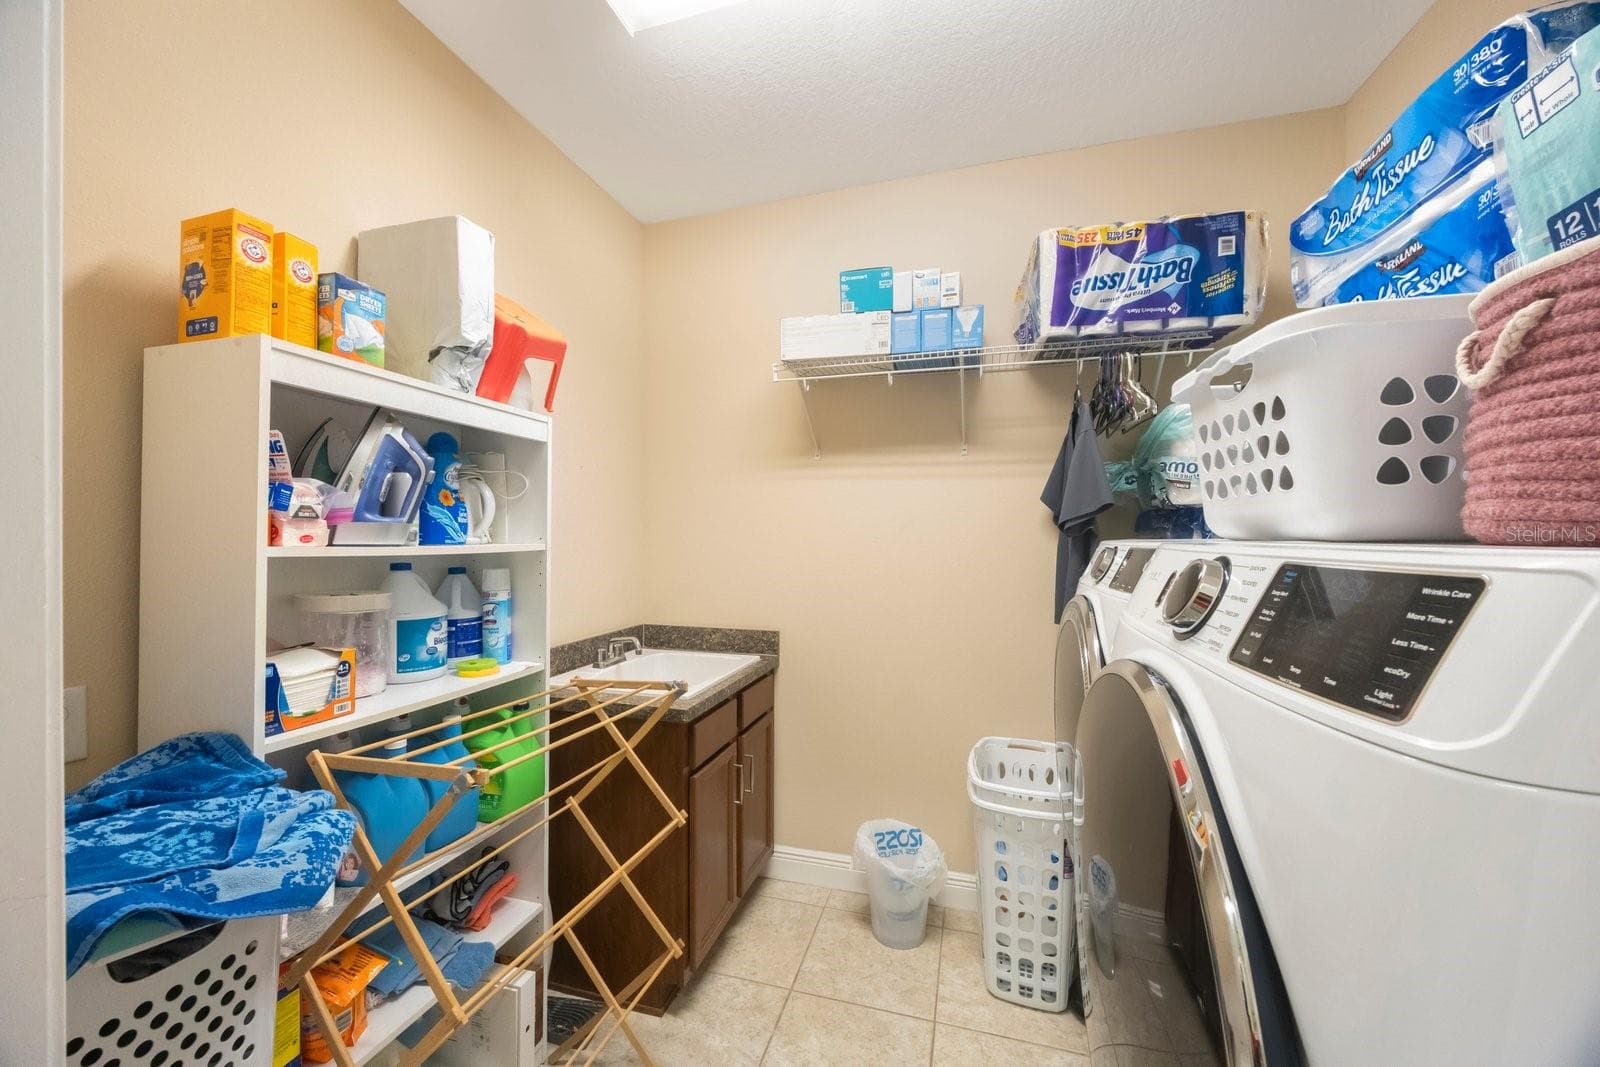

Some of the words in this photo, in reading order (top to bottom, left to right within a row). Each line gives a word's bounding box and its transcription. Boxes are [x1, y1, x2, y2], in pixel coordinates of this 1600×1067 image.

[1324, 181, 1375, 246] Bath
[1372, 135, 1436, 205] Tissue
[1554, 211, 1584, 240] 12
[1559, 230, 1587, 249] ROLLS
[1137, 257, 1194, 288] Bath
[1422, 587, 1450, 597] Wrinkle
[1451, 590, 1472, 599] Care
[1406, 612, 1426, 622] More
[1427, 615, 1447, 625] Time
[1391, 638, 1409, 648] Less
[1409, 641, 1430, 651] Time
[1374, 688, 1394, 701] Light
